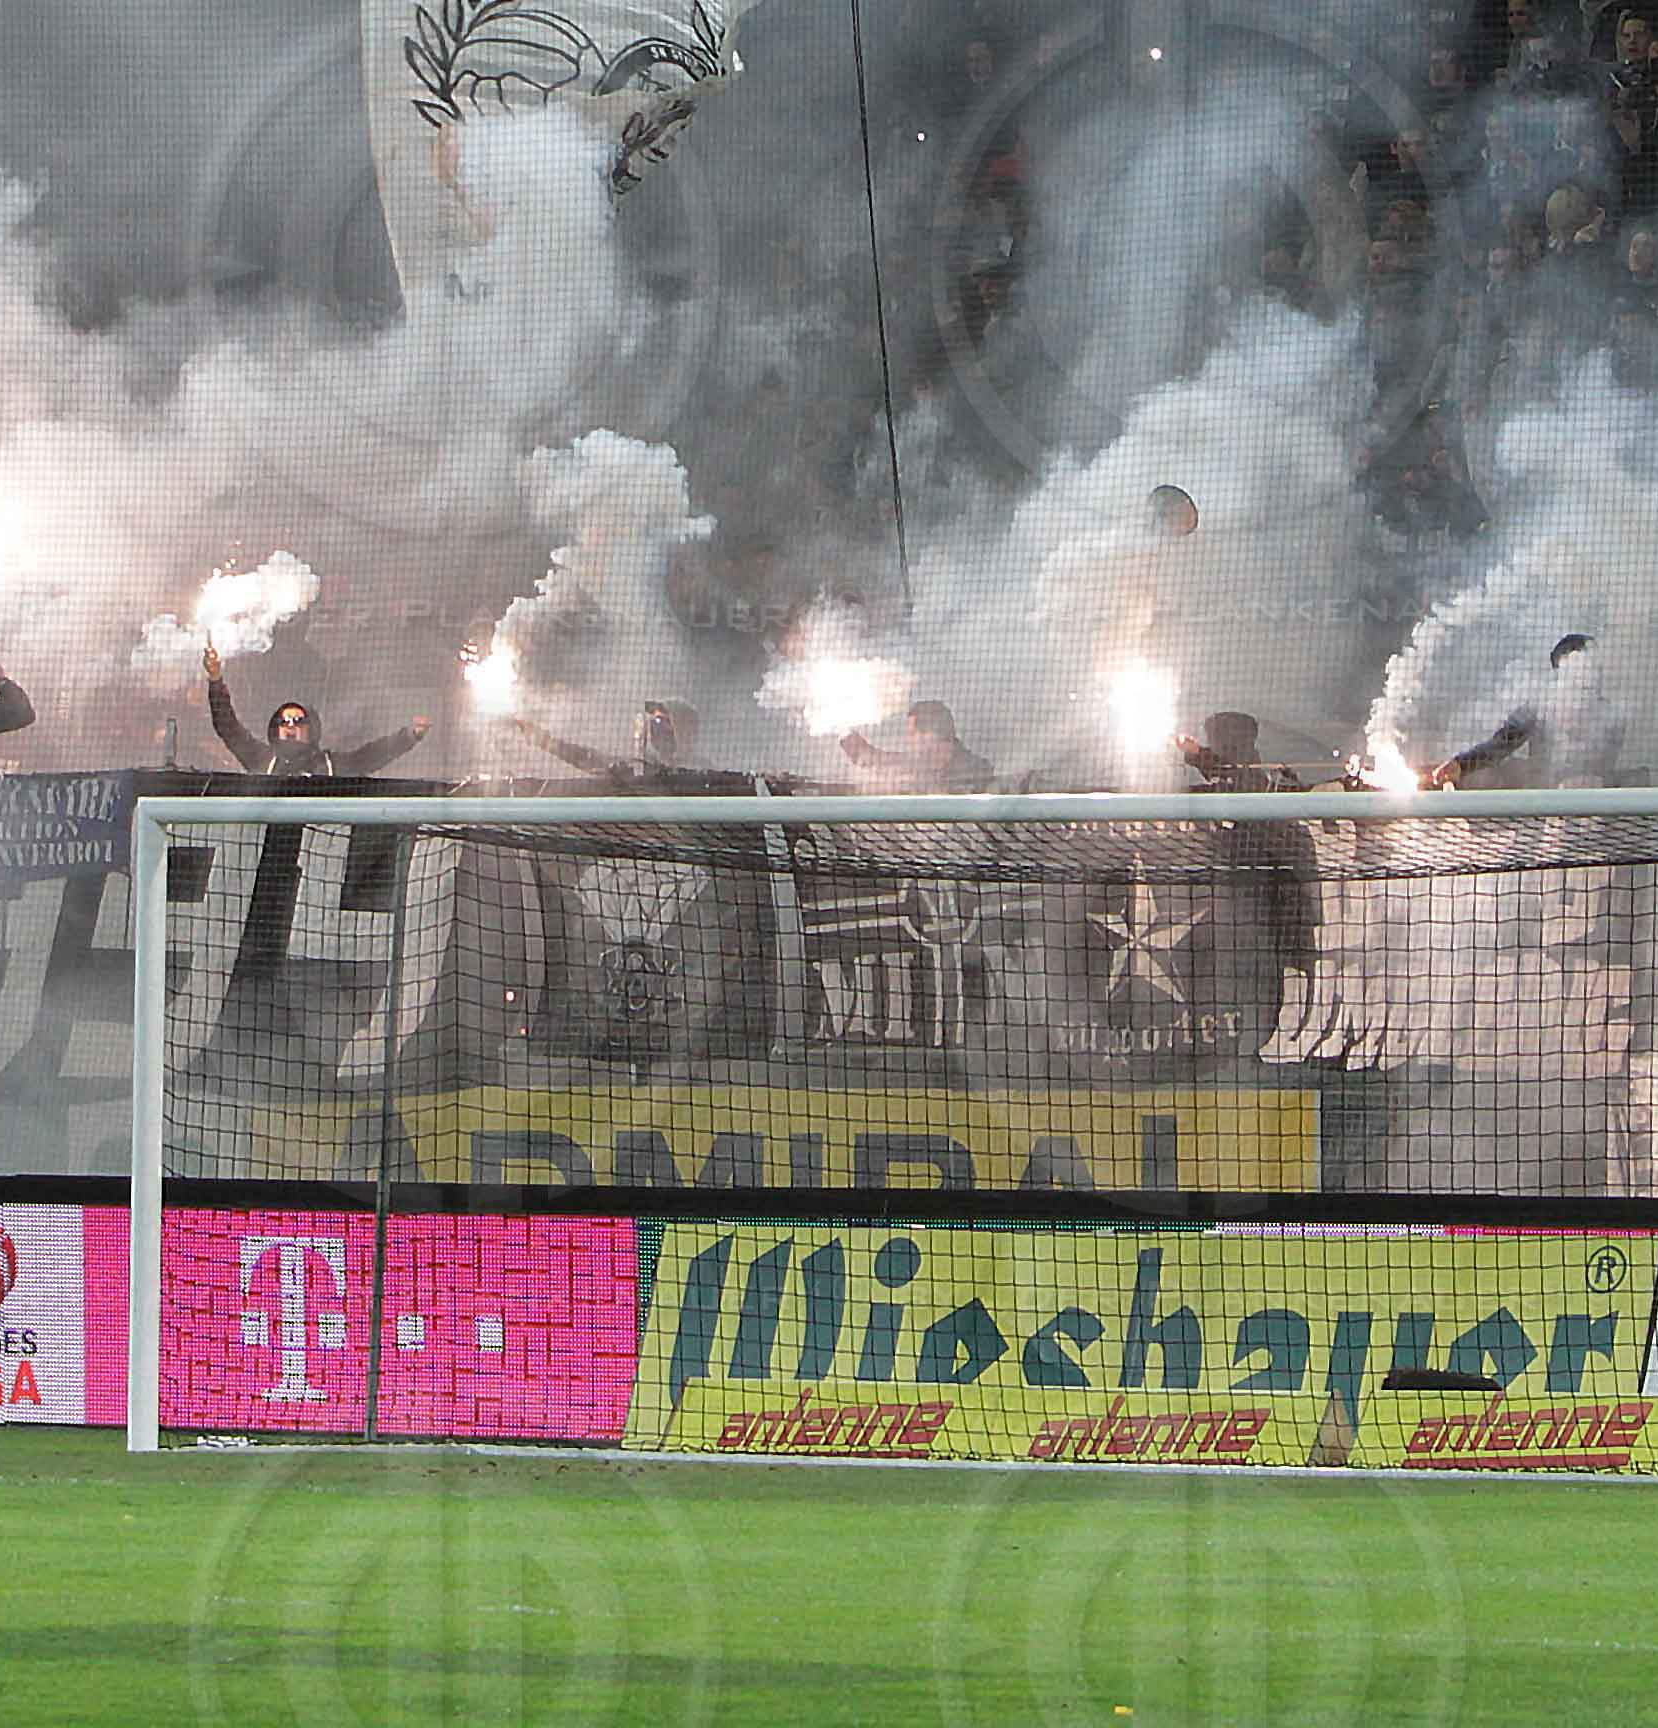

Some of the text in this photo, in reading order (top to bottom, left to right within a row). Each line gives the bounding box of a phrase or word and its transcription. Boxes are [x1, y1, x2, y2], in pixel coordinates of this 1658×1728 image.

[717, 1385, 957, 1452] antenne
[1028, 1394, 1272, 1459] antenne
[1405, 1396, 1654, 1455] antenne
